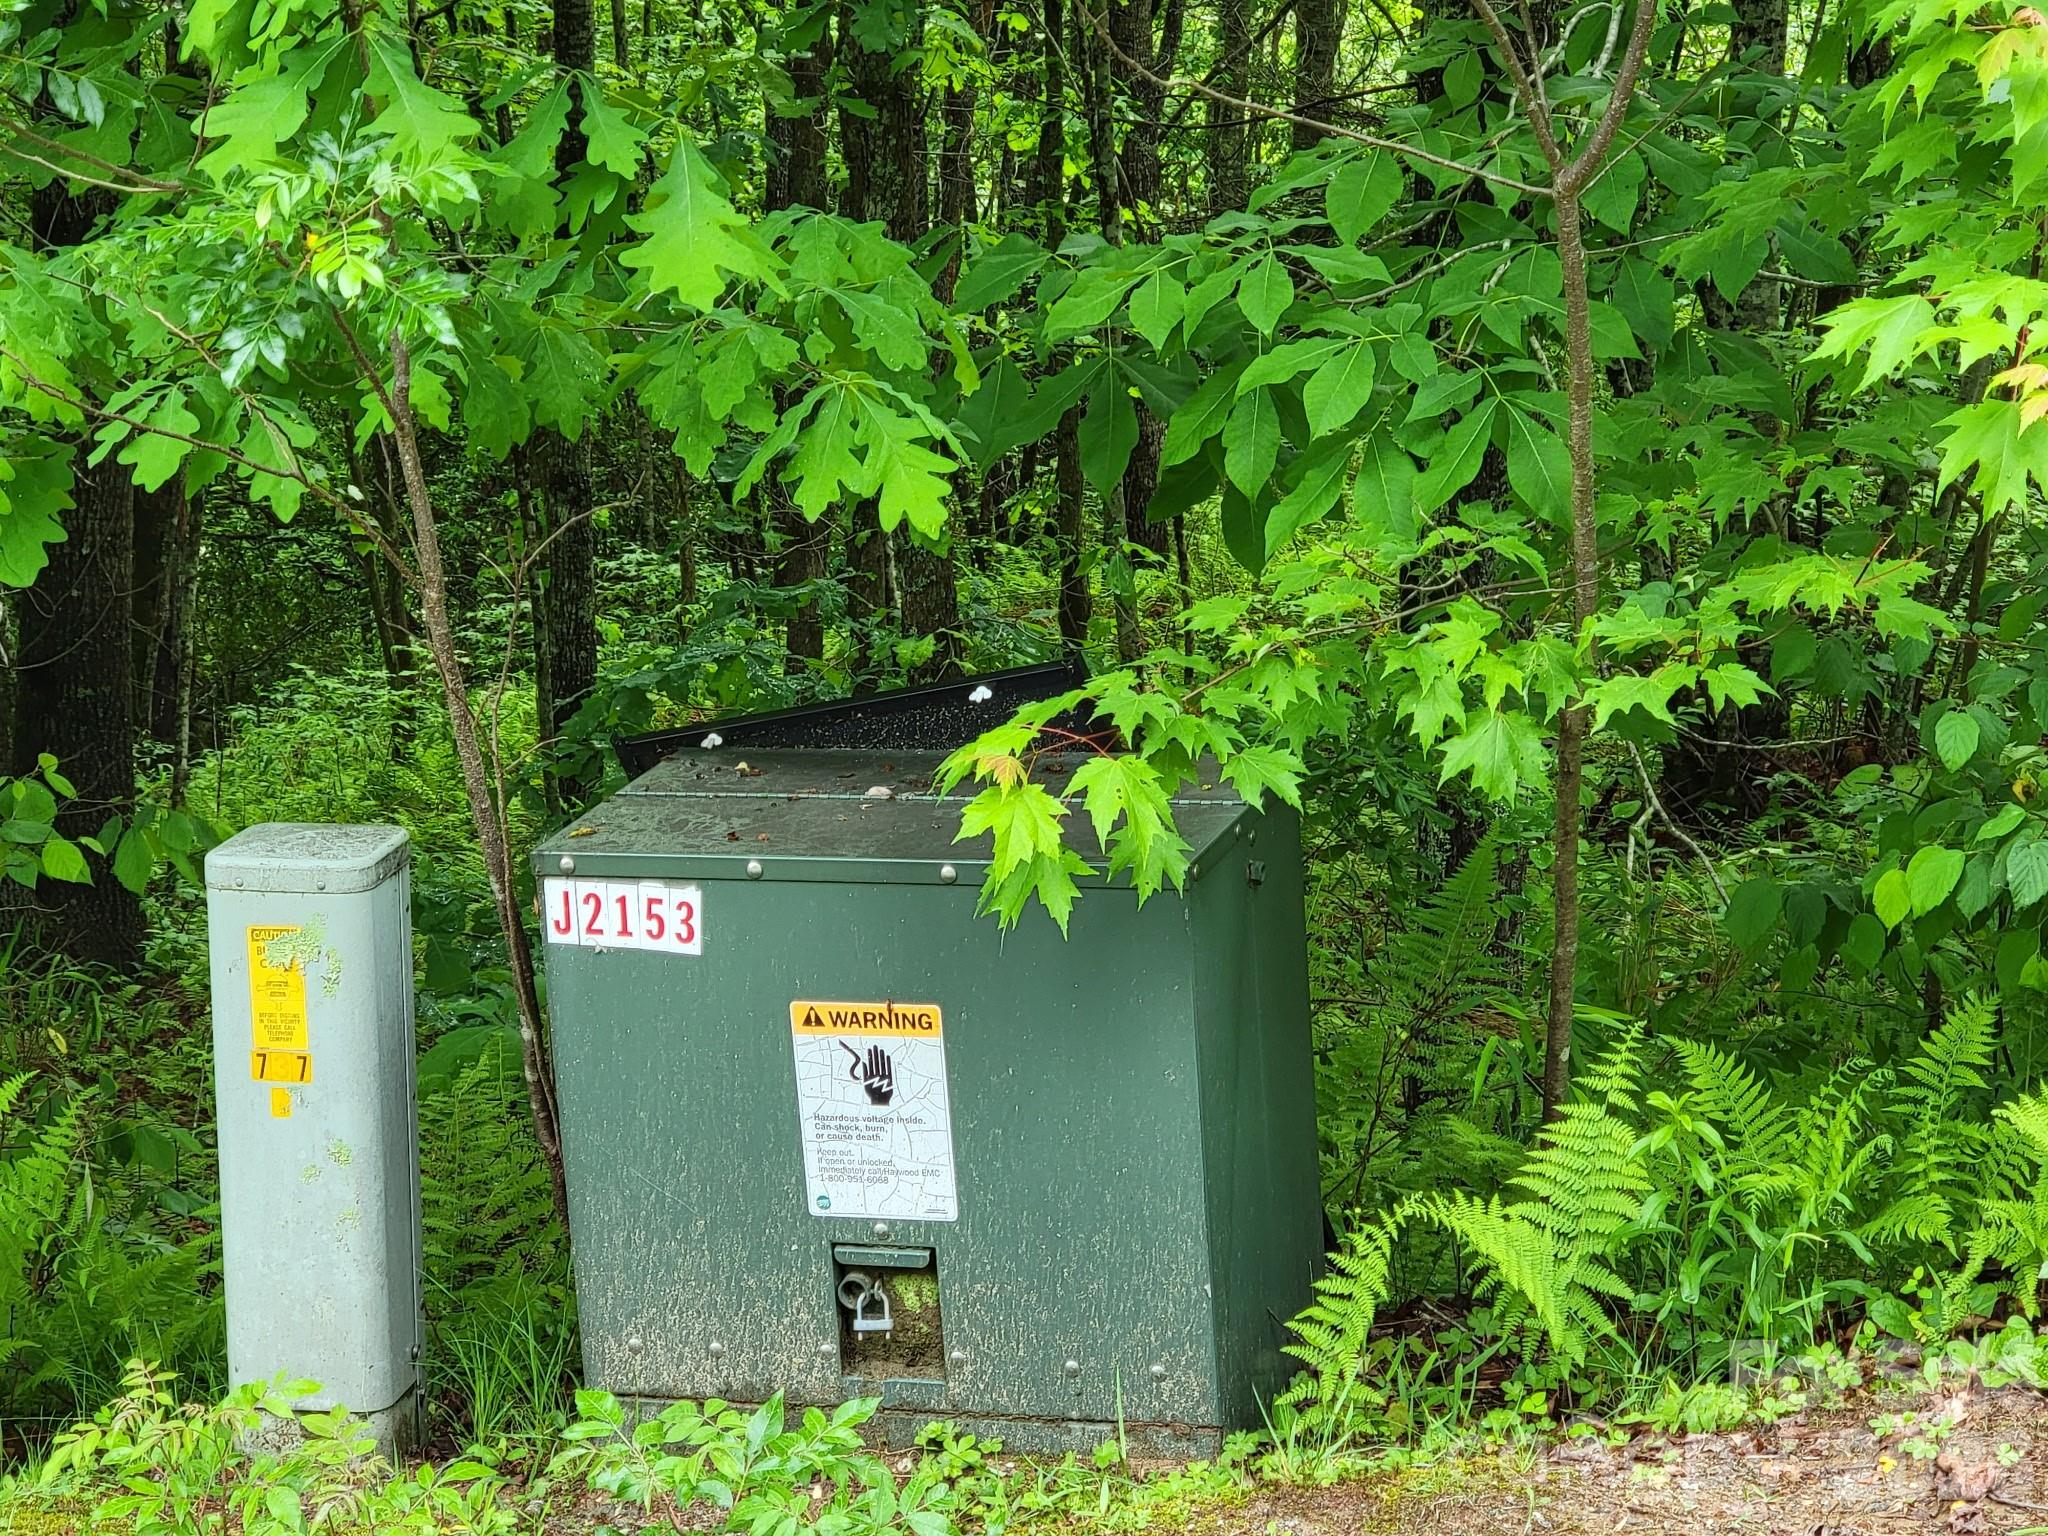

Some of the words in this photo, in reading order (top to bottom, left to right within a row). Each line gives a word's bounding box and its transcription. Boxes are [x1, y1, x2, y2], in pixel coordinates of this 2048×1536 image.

[553, 889, 695, 945] J2153
[828, 1010, 934, 1031] WARNING
[813, 1113, 860, 1123] Hazardous
[862, 1115, 895, 1126] voltage
[814, 1122, 832, 1131] Can
[834, 1123, 863, 1133] shock,
[865, 1125, 889, 1134] burn,
[827, 1133, 854, 1141] cause
[855, 1133, 884, 1142] death.
[817, 1147, 837, 1157] Keep
[824, 1158, 845, 1166] open
[884, 1168, 920, 1178] Haywood
